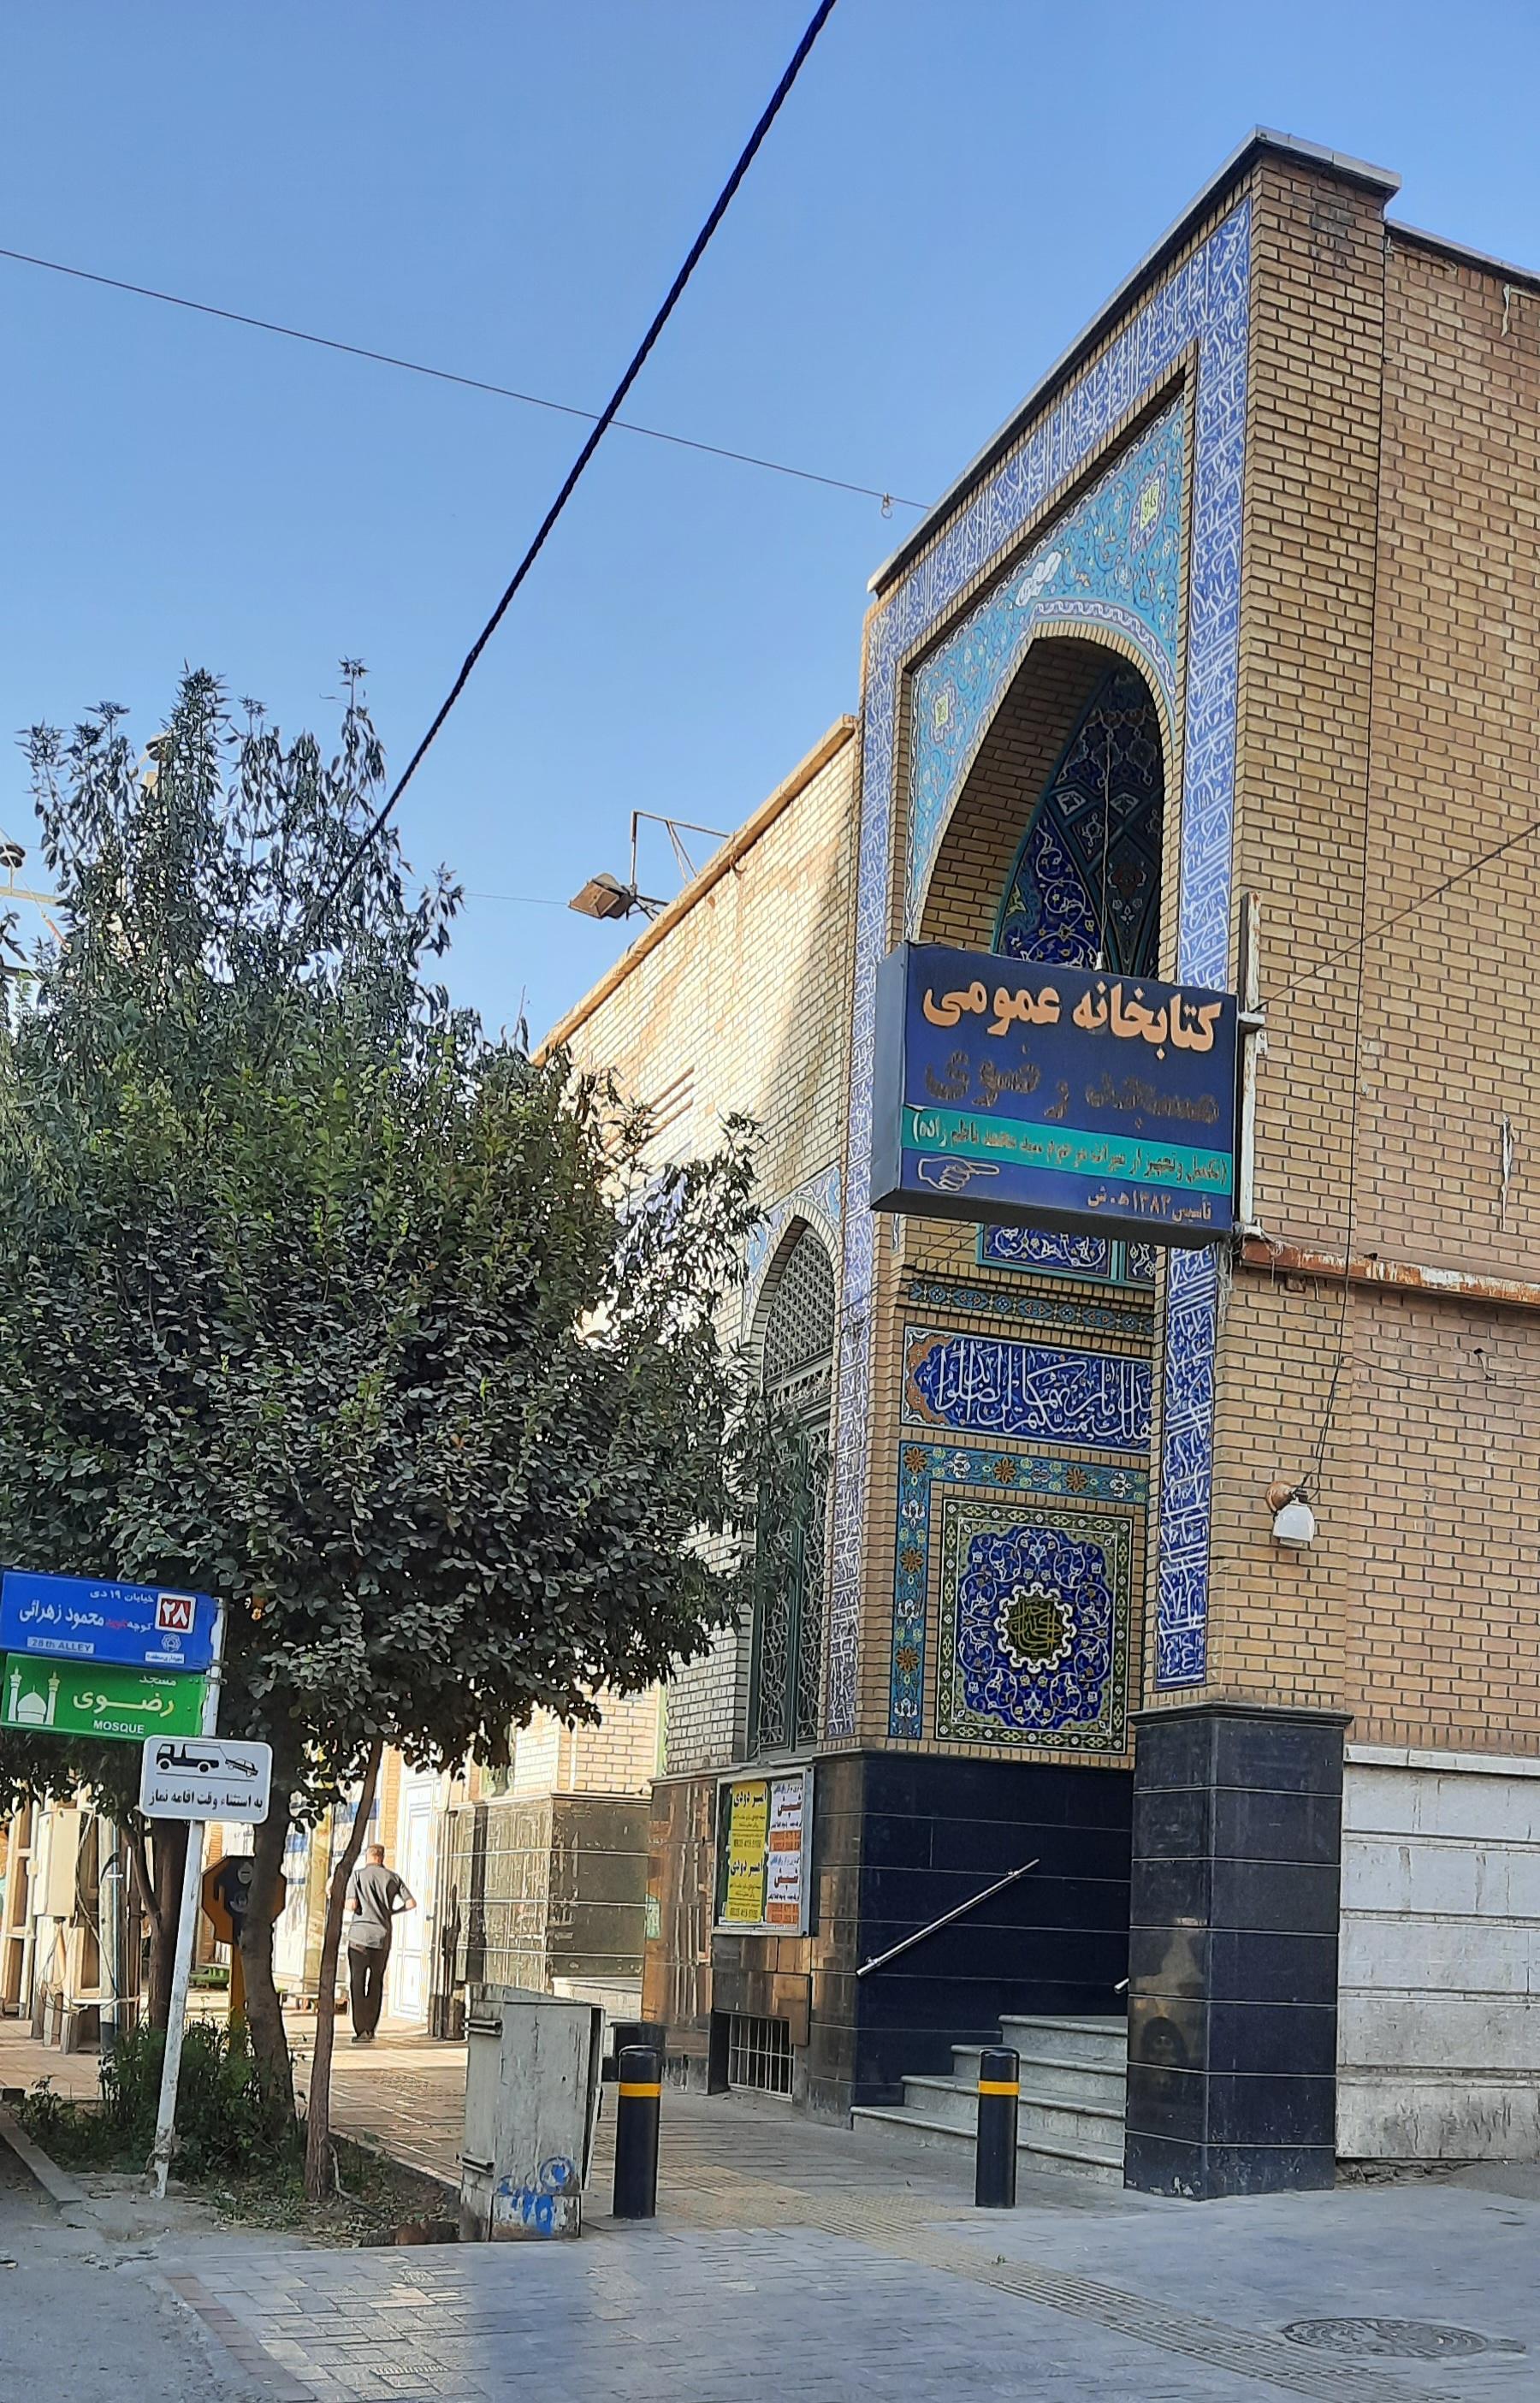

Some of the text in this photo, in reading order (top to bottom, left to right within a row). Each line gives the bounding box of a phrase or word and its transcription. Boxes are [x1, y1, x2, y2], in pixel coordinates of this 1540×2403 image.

[923, 981, 1222, 1059] کتابخانه عمومی
[925, 1043, 1220, 1129] مسجد رضوی
[90, 1589, 154, 1604] خیابان ۱۹ دی
[65, 1607, 104, 1630] محمود
[161, 1599, 188, 1627] ۲۸
[127, 1621, 154, 1633] کوچه
[57, 1642, 91, 1652] ALLEY
[139, 1675, 177, 1688] مسجد
[73, 1691, 175, 1718] رضوی
[93, 1719, 145, 1735] MOSQUE
[148, 1788, 169, 1806] نماز
[171, 1789, 194, 1804] اقامه
[197, 1790, 217, 1810] وقت
[253, 1798, 263, 1812] به
